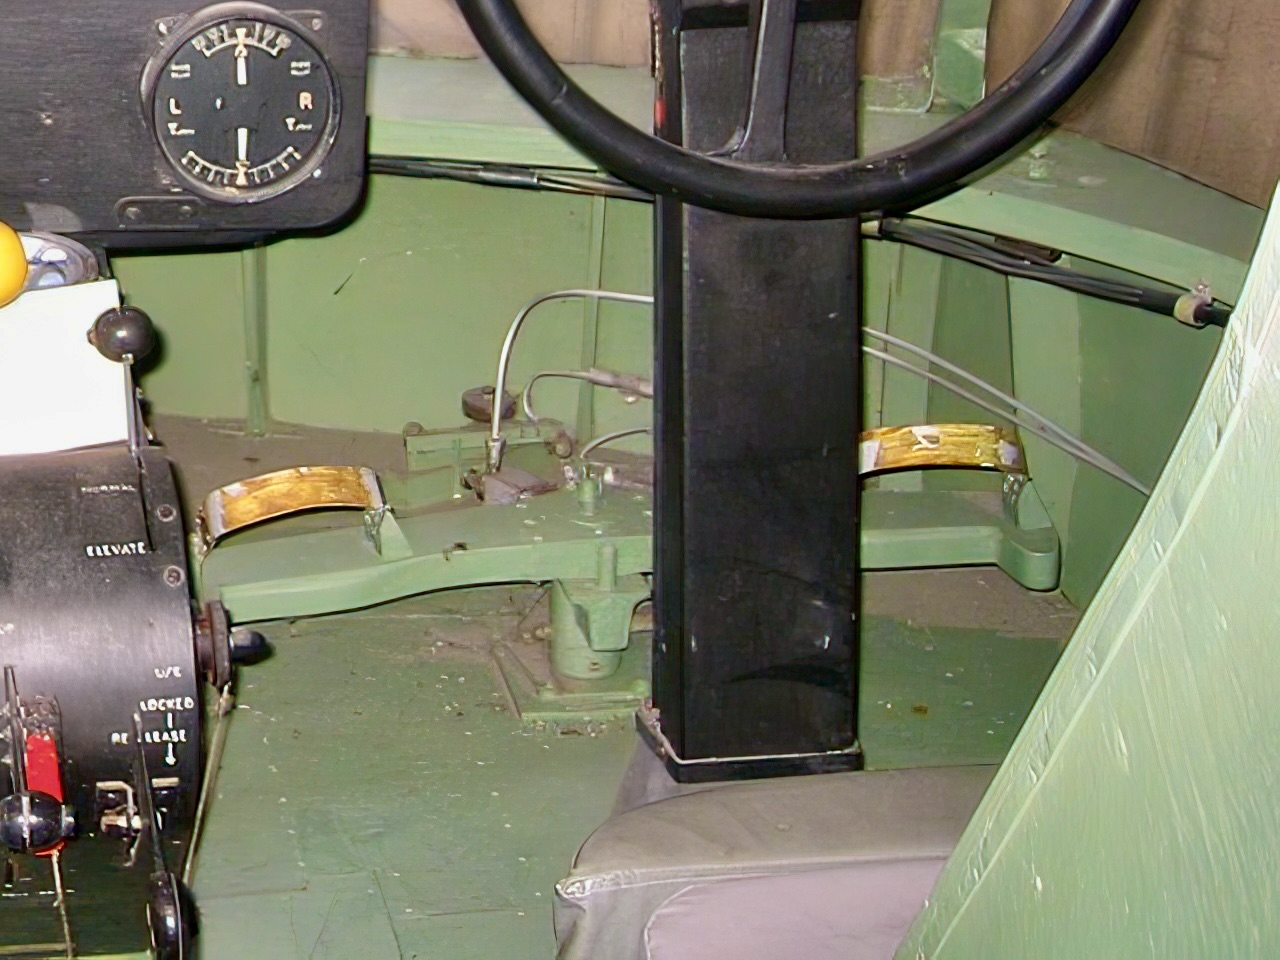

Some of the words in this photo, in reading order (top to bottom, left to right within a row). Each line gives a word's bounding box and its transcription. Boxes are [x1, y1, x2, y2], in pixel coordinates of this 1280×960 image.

[170, 98, 182, 115] L
[86, 541, 146, 557] ELEVATE
[139, 696, 195, 712] LOCKED
